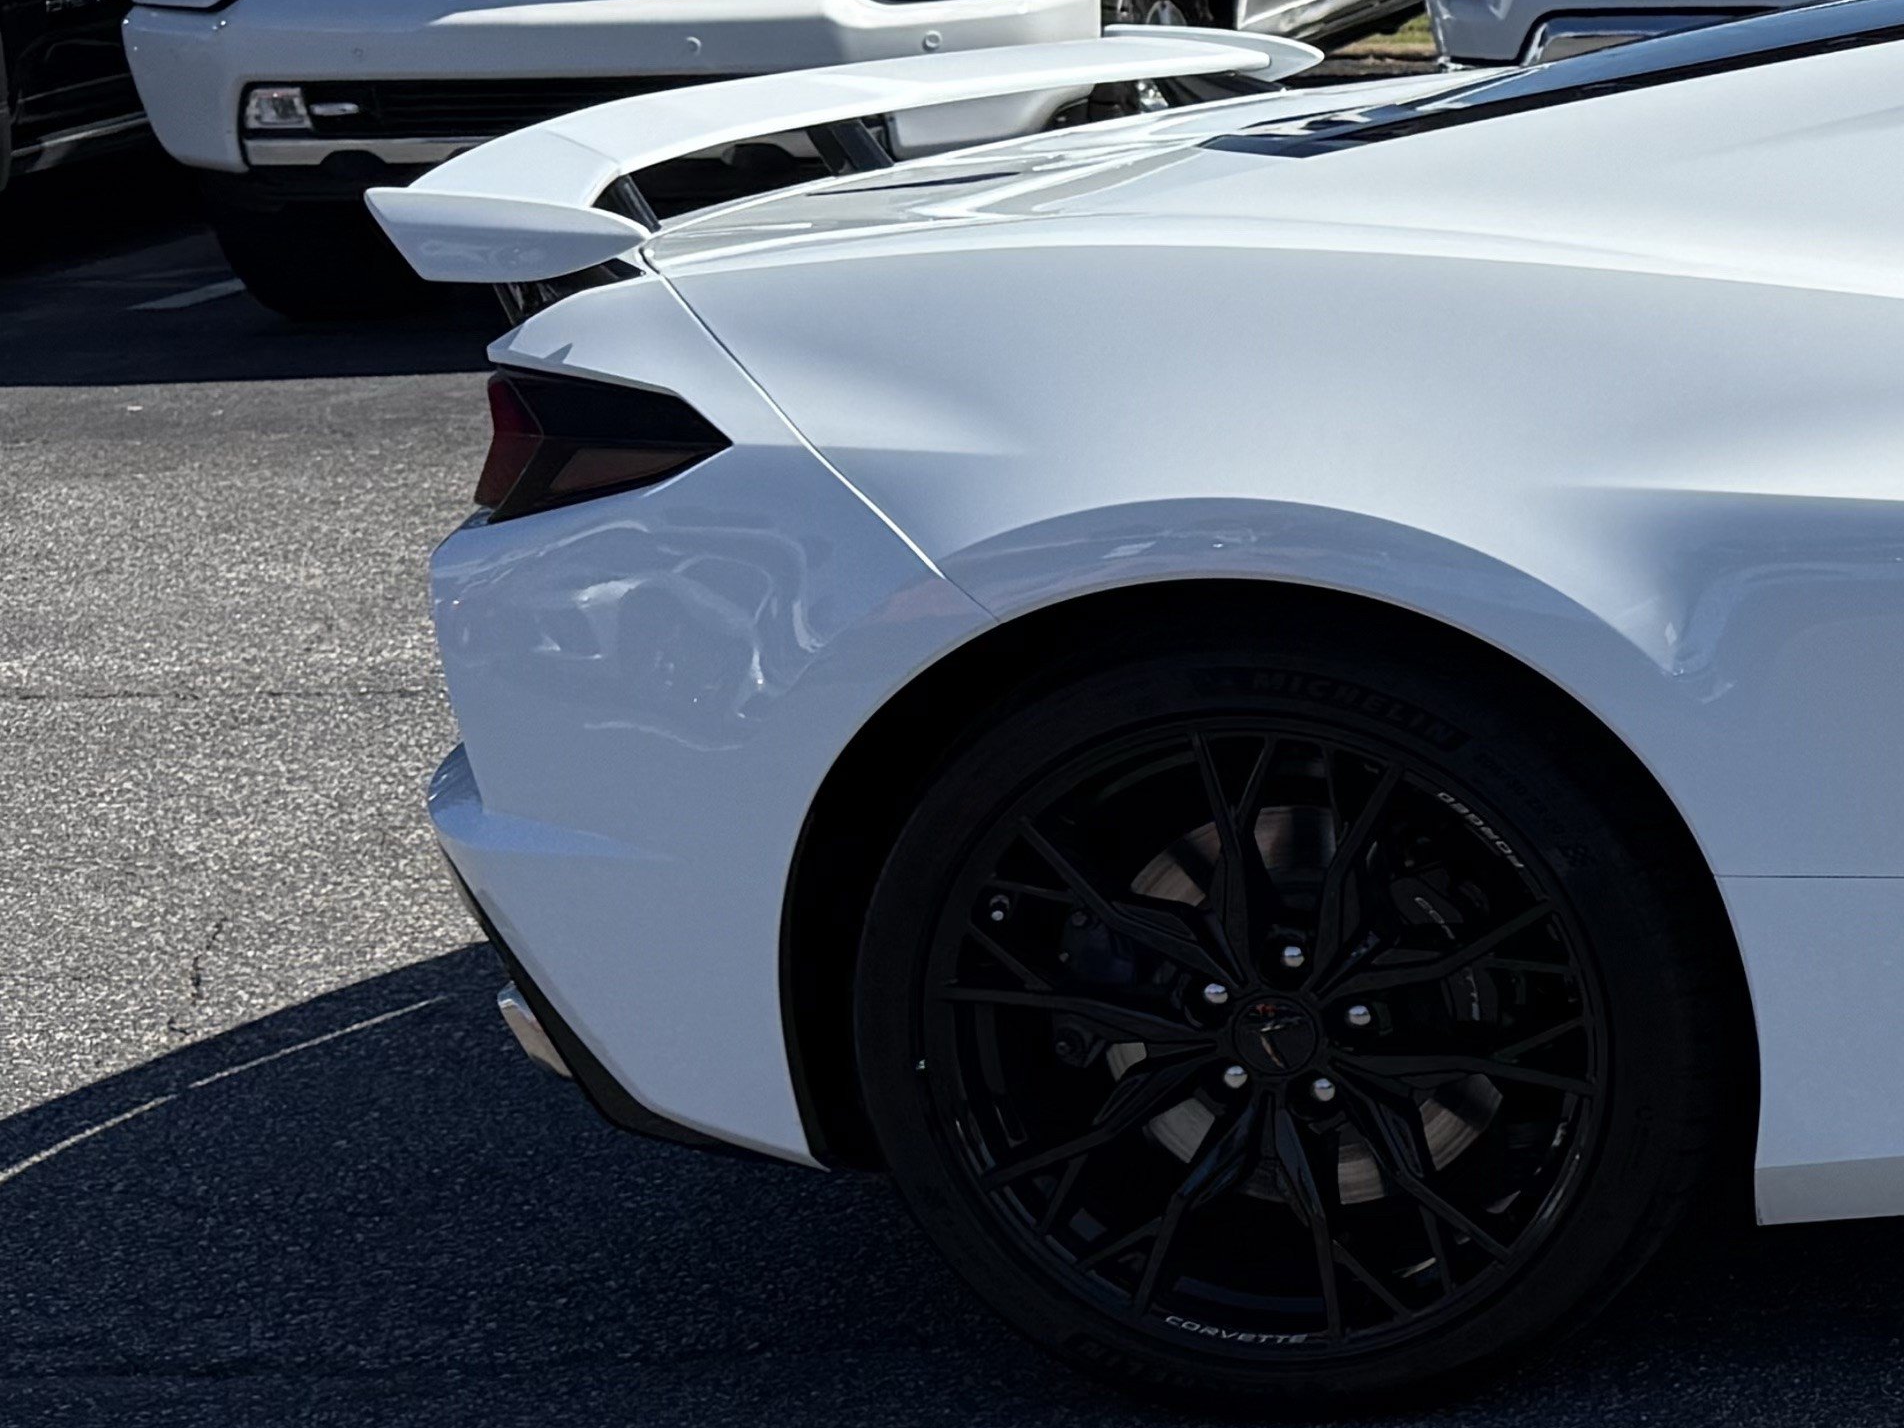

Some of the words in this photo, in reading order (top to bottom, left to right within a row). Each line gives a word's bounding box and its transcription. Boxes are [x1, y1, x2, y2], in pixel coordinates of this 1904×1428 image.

[1250, 670, 1456, 754] MICHELIN
[1436, 790, 1526, 870] FORGED
[1163, 1314, 1311, 1346] CORVETTE
